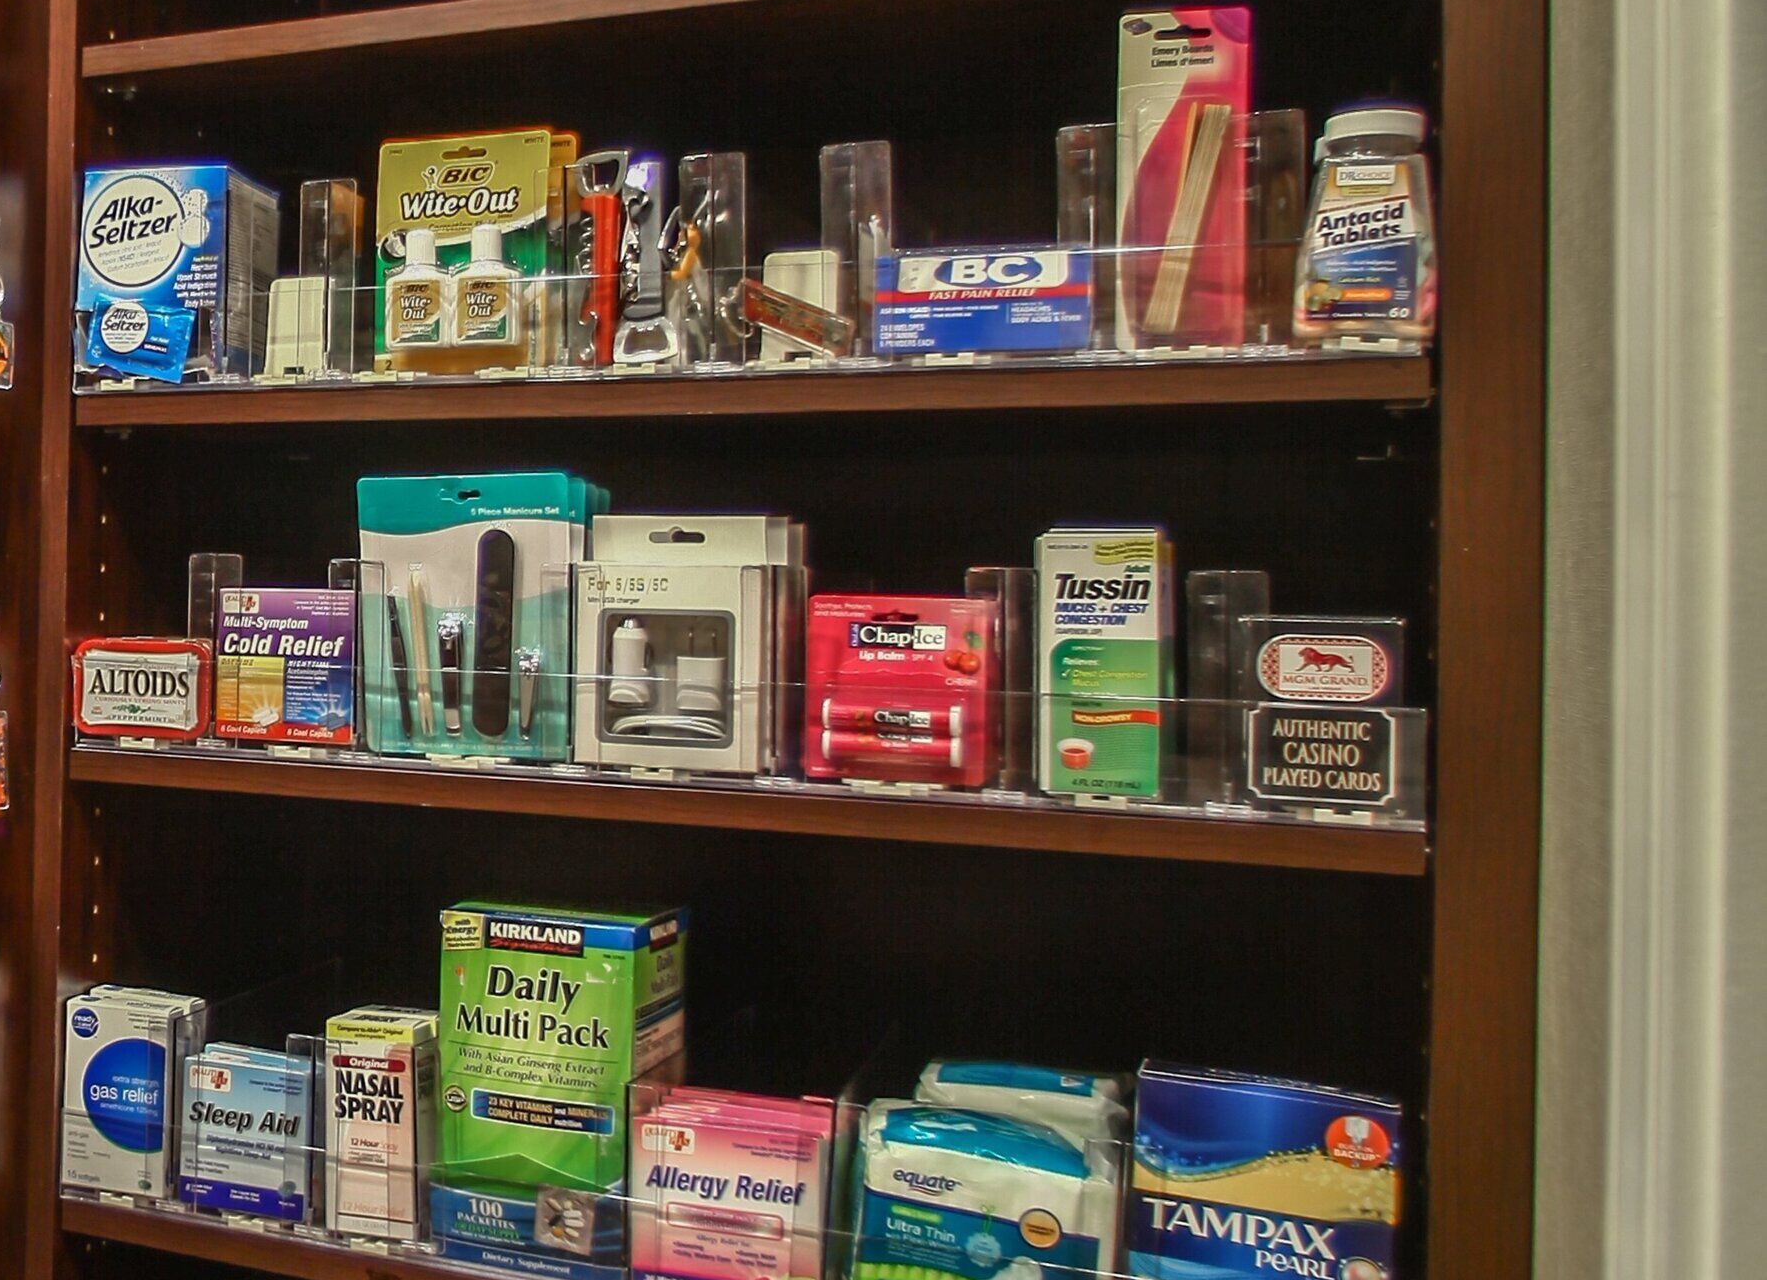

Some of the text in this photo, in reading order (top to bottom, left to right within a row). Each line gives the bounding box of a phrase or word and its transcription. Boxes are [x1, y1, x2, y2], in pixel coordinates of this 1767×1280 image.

[1152, 45, 1213, 56] Emery Boards
[1151, 59, 1177, 67] Limes
[442, 167, 489, 184] BIC
[96, 195, 164, 224] Alka-
[1317, 202, 1405, 233] Antacid
[89, 213, 177, 249] Seltzer
[1320, 223, 1401, 248] Tablets
[950, 257, 1030, 284] BC
[928, 288, 1038, 300] FAST PAIN RELIEF
[403, 308, 426, 320] Out
[469, 304, 492, 318] Out
[1389, 307, 1409, 318] 60
[102, 320, 146, 331] Seltzer
[385, 360, 393, 370] 2
[503, 507, 542, 515] Manicure
[545, 506, 559, 514] Set
[587, 578, 610, 591] For
[1055, 573, 1151, 600] Tussin
[616, 597, 640, 605] charger
[1055, 603, 1149, 613] MUCUS CHEST
[223, 616, 309, 631] Multi-Symptom
[1055, 615, 1127, 625] CONGESTION
[224, 633, 346, 657] Cold Relief
[859, 650, 905, 661] Lip Balm
[88, 669, 189, 697] ALTOIDS
[1072, 679, 1100, 687] Mucus
[1099, 671, 1148, 680] Congestion
[1282, 674, 1368, 687] MGM GRAND
[110, 715, 168, 723] PEPPERMINT
[242, 726, 267, 735] Caplets
[293, 729, 334, 738] Cool Caplets
[1272, 719, 1370, 741] AUTHENTIC
[1283, 741, 1360, 766] CASINO
[1263, 767, 1381, 792] PLAYED CARDS
[446, 925, 477, 936] Energy
[490, 921, 581, 945] KIRKLAND
[487, 965, 582, 1015] Daily
[74, 1014, 96, 1024] ready
[455, 1003, 610, 1050] Multi Pack
[349, 1056, 389, 1070] Original
[458, 1047, 605, 1076] With Asian Ginseng Extract
[112, 1075, 159, 1089] extra strength
[463, 1063, 598, 1089] and B-Complex Vitamins
[335, 1070, 403, 1099] NASAL
[90, 1084, 159, 1105] gas relief
[100, 1102, 135, 1113] simethicone
[335, 1094, 404, 1124] SPRAY
[488, 1096, 498, 1106] 23
[498, 1097, 514, 1107] KEY
[515, 1100, 553, 1113] VITAMINS
[554, 1106, 566, 1115] and
[189, 1101, 302, 1137] Sleep Aid
[488, 1107, 553, 1125] COMPLETE DAILY
[350, 1137, 379, 1148] 12 Hour
[1334, 1149, 1376, 1162] BACKUP
[67, 1169, 77, 1179] 15
[893, 1168, 957, 1192] equate
[646, 1165, 807, 1206] Allergy Relief
[343, 1201, 353, 1211] 12
[354, 1201, 378, 1215] Hour
[469, 1198, 503, 1218] 100
[457, 1211, 516, 1230] PACKETTES
[1141, 1196, 1336, 1260] TAMPAX
[886, 1217, 956, 1243] Ultra Thin
[696, 1234, 718, 1244] Allergy
[482, 1251, 571, 1274] Dietary Supplement
